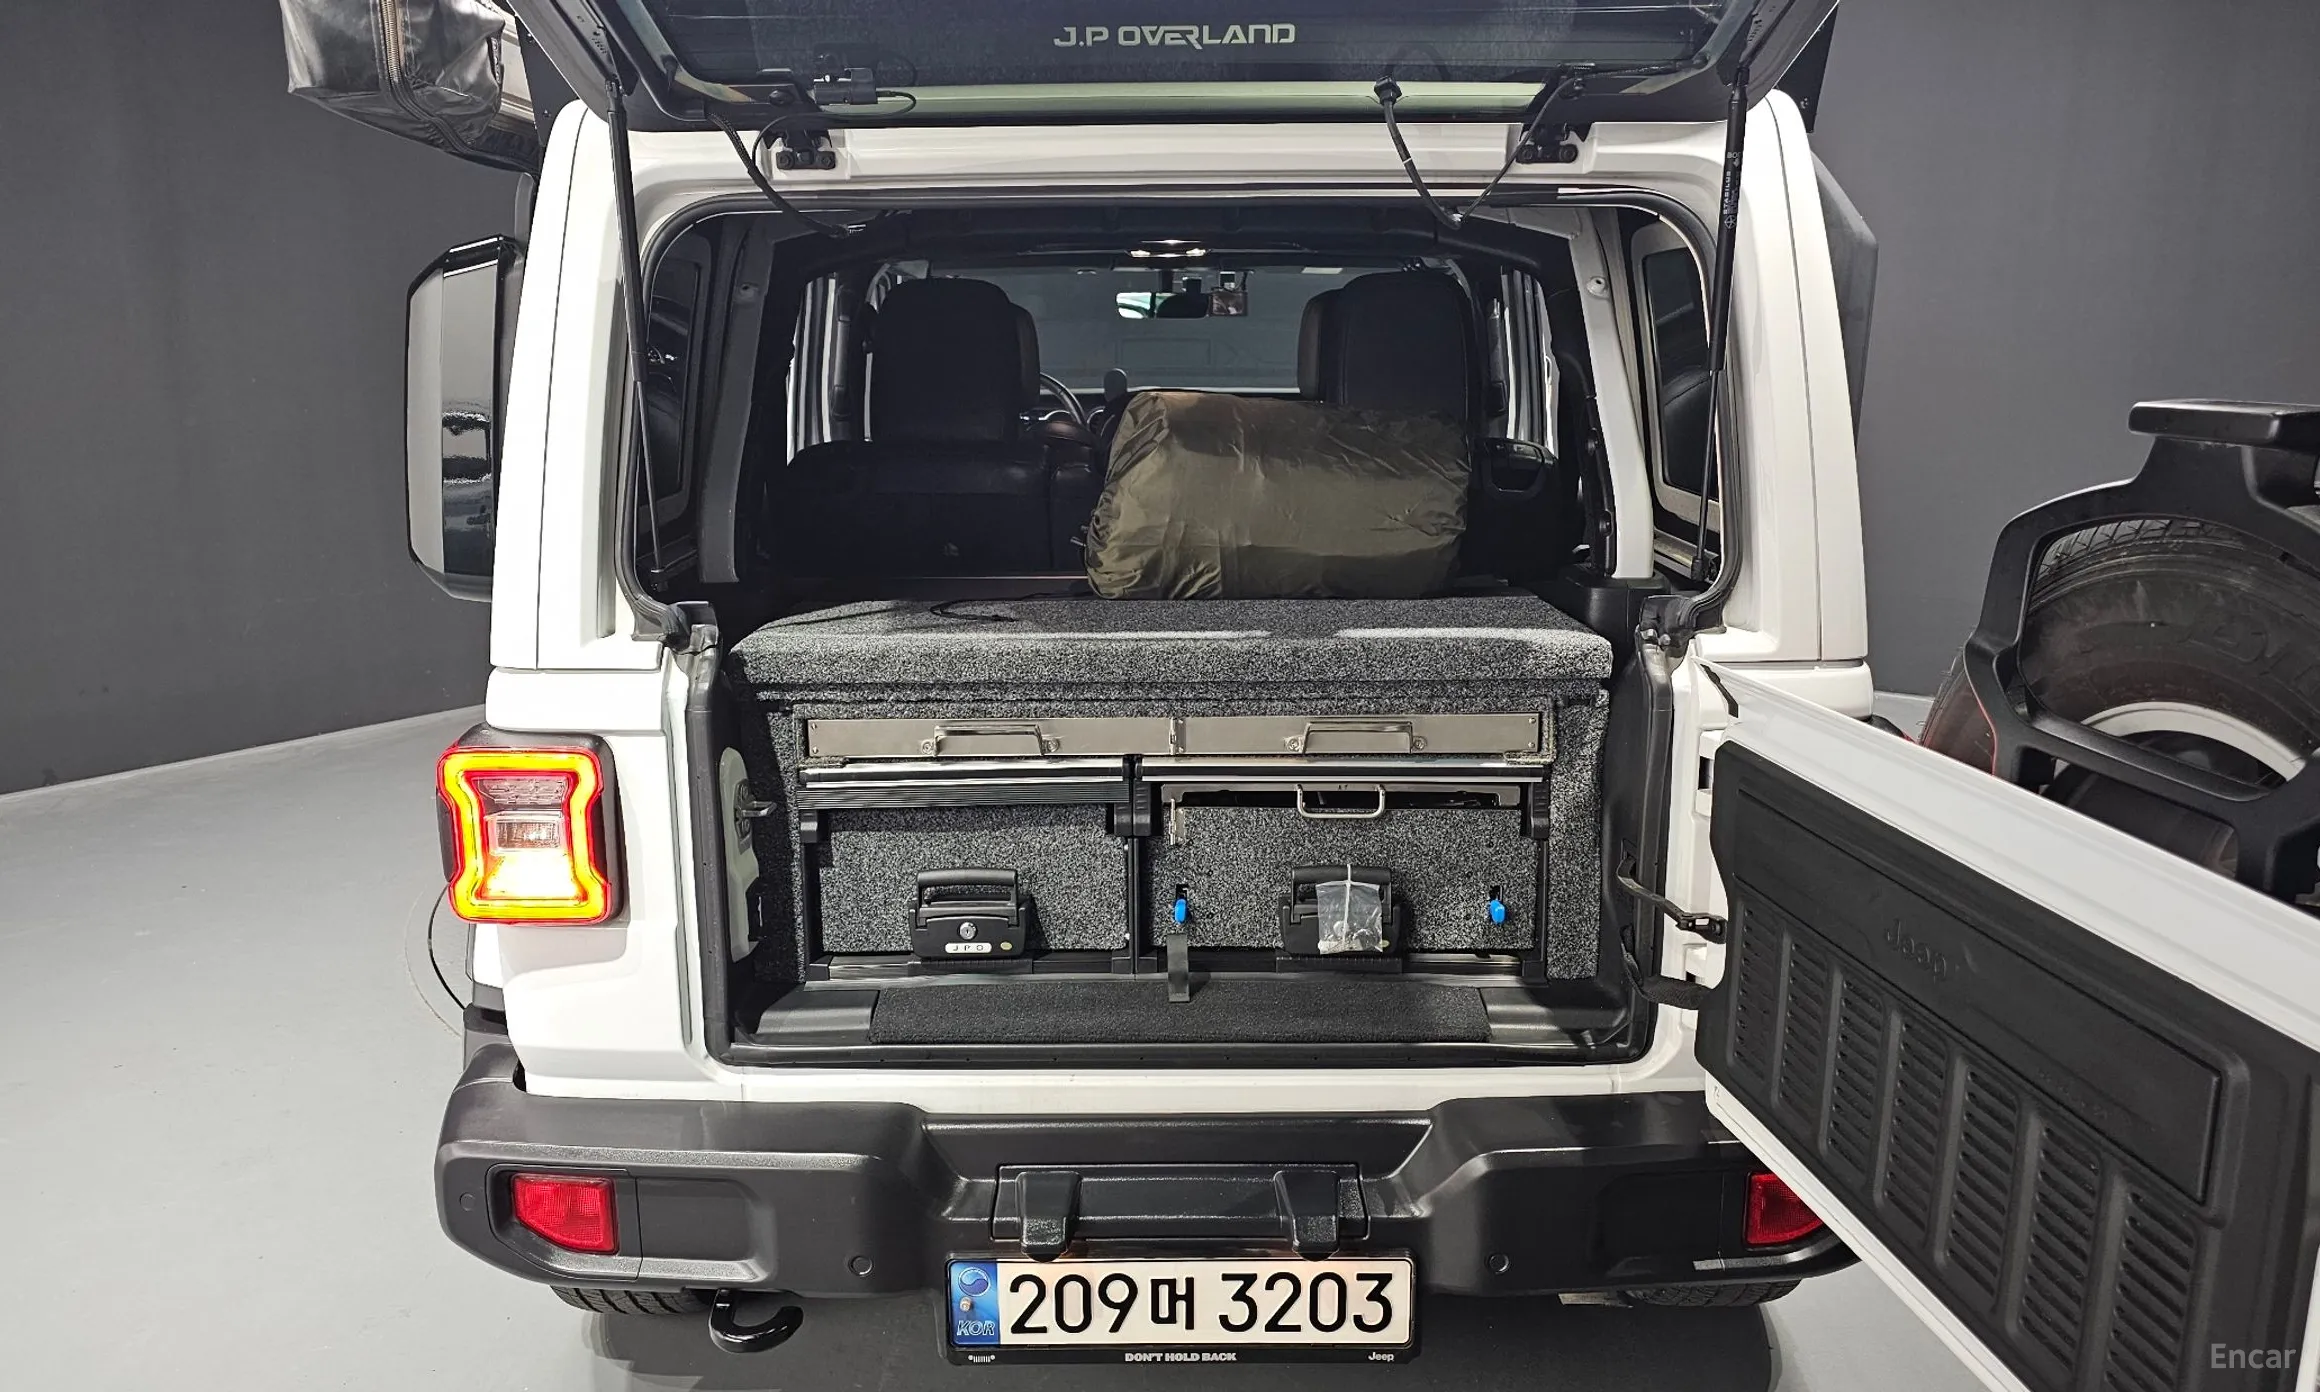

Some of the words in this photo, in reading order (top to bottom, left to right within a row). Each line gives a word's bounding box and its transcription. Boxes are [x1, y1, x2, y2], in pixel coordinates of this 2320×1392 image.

[1053, 26, 1109, 47] J.P
[1118, 23, 1295, 50] OVERLAND
[1884, 917, 1948, 985] Jeep
[1009, 1273, 1195, 1334] 209머
[1218, 1272, 1394, 1333] 3203
[956, 1320, 996, 1336] KOR
[1124, 1352, 1163, 1362] DON'T
[1164, 1352, 1200, 1362] HOLD
[1201, 1352, 1237, 1362] BACK
[1368, 1351, 1395, 1362] Jeep
